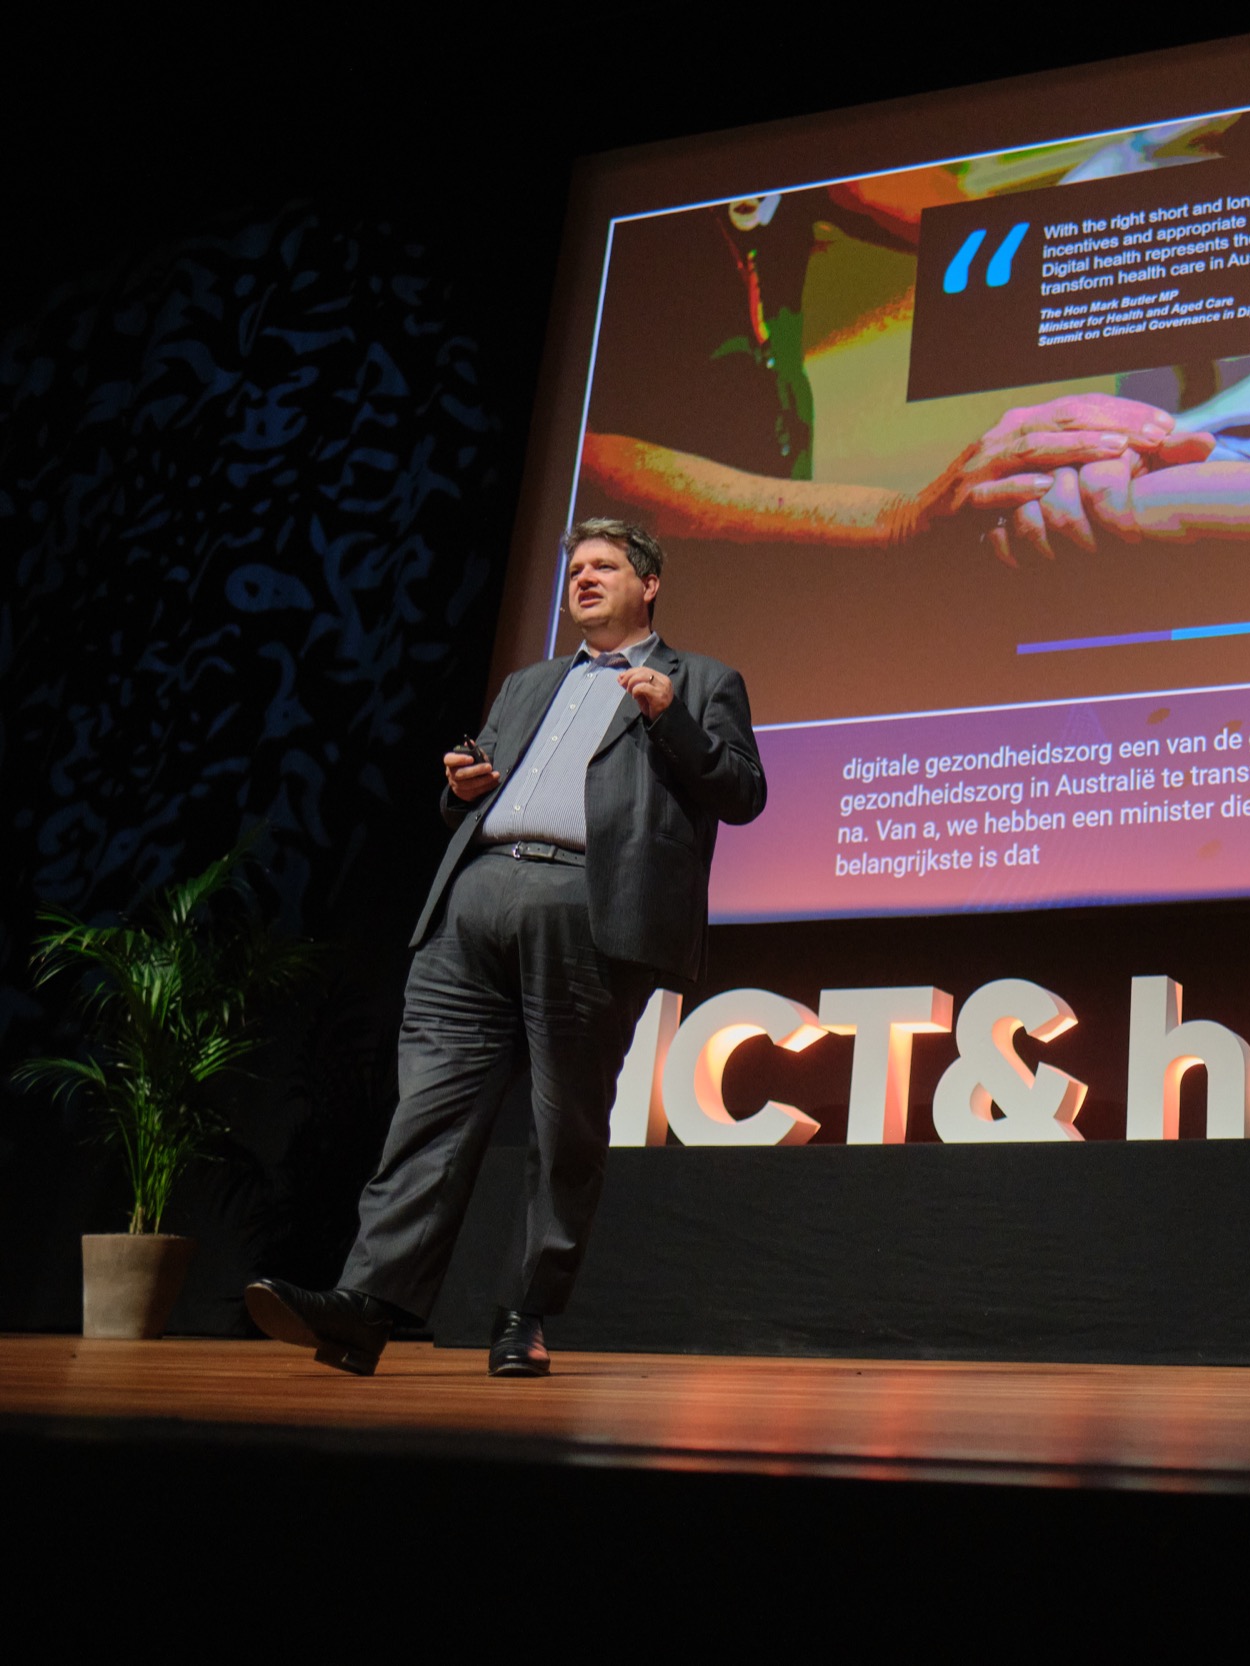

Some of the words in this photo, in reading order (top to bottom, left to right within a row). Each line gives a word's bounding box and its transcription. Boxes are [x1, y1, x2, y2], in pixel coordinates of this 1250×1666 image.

[1042, 236, 1118, 258] incentives
[1122, 228, 1152, 245] and
[1156, 215, 1246, 241] appropriate
[1043, 222, 1078, 239] With
[1081, 219, 1107, 233] the
[1110, 210, 1145, 230] right
[1148, 204, 1188, 222] short
[1192, 198, 1222, 215] and
[1040, 275, 1113, 296] transform
[1117, 265, 1165, 284] health
[1169, 261, 1205, 276] care
[1209, 255, 1223, 270] in
[1041, 257, 1089, 277] Digital
[1093, 250, 1140, 269] health
[1144, 236, 1229, 261] represents
[1038, 319, 1085, 333] Minister
[1086, 316, 1105, 326] for
[1105, 310, 1143, 323] Health
[1145, 304, 1169, 317] and
[1170, 299, 1203, 315] Aged
[1204, 297, 1234, 309] Care
[1039, 309, 1062, 319] The
[1062, 305, 1087, 316] Hon
[1089, 298, 1118, 312] Mark
[1158, 289, 1179, 302] MP
[1037, 331, 1083, 346] Summit
[1083, 330, 1100, 339] on
[1102, 321, 1146, 337] Clinical
[1147, 313, 1220, 330] Governance
[1222, 309, 1234, 319] in
[842, 753, 919, 783] digitale
[925, 741, 1112, 778] gezondheidszorg
[1119, 739, 1159, 758] een
[1166, 735, 1206, 754] van
[1213, 727, 1242, 750] de
[840, 780, 1023, 816] gezondheidszorg
[1030, 776, 1048, 798] in
[1055, 767, 1154, 796] Australië
[1161, 768, 1183, 788] te
[837, 826, 867, 843] na.
[876, 818, 916, 840] Van
[922, 821, 940, 840] a,
[946, 818, 977, 836] we
[984, 808, 1065, 834] hebben
[1072, 809, 1112, 828] een
[1120, 799, 1214, 824] minister
[835, 847, 972, 878] belangrijkste
[979, 845, 997, 867] is
[1003, 842, 1039, 866] dat
